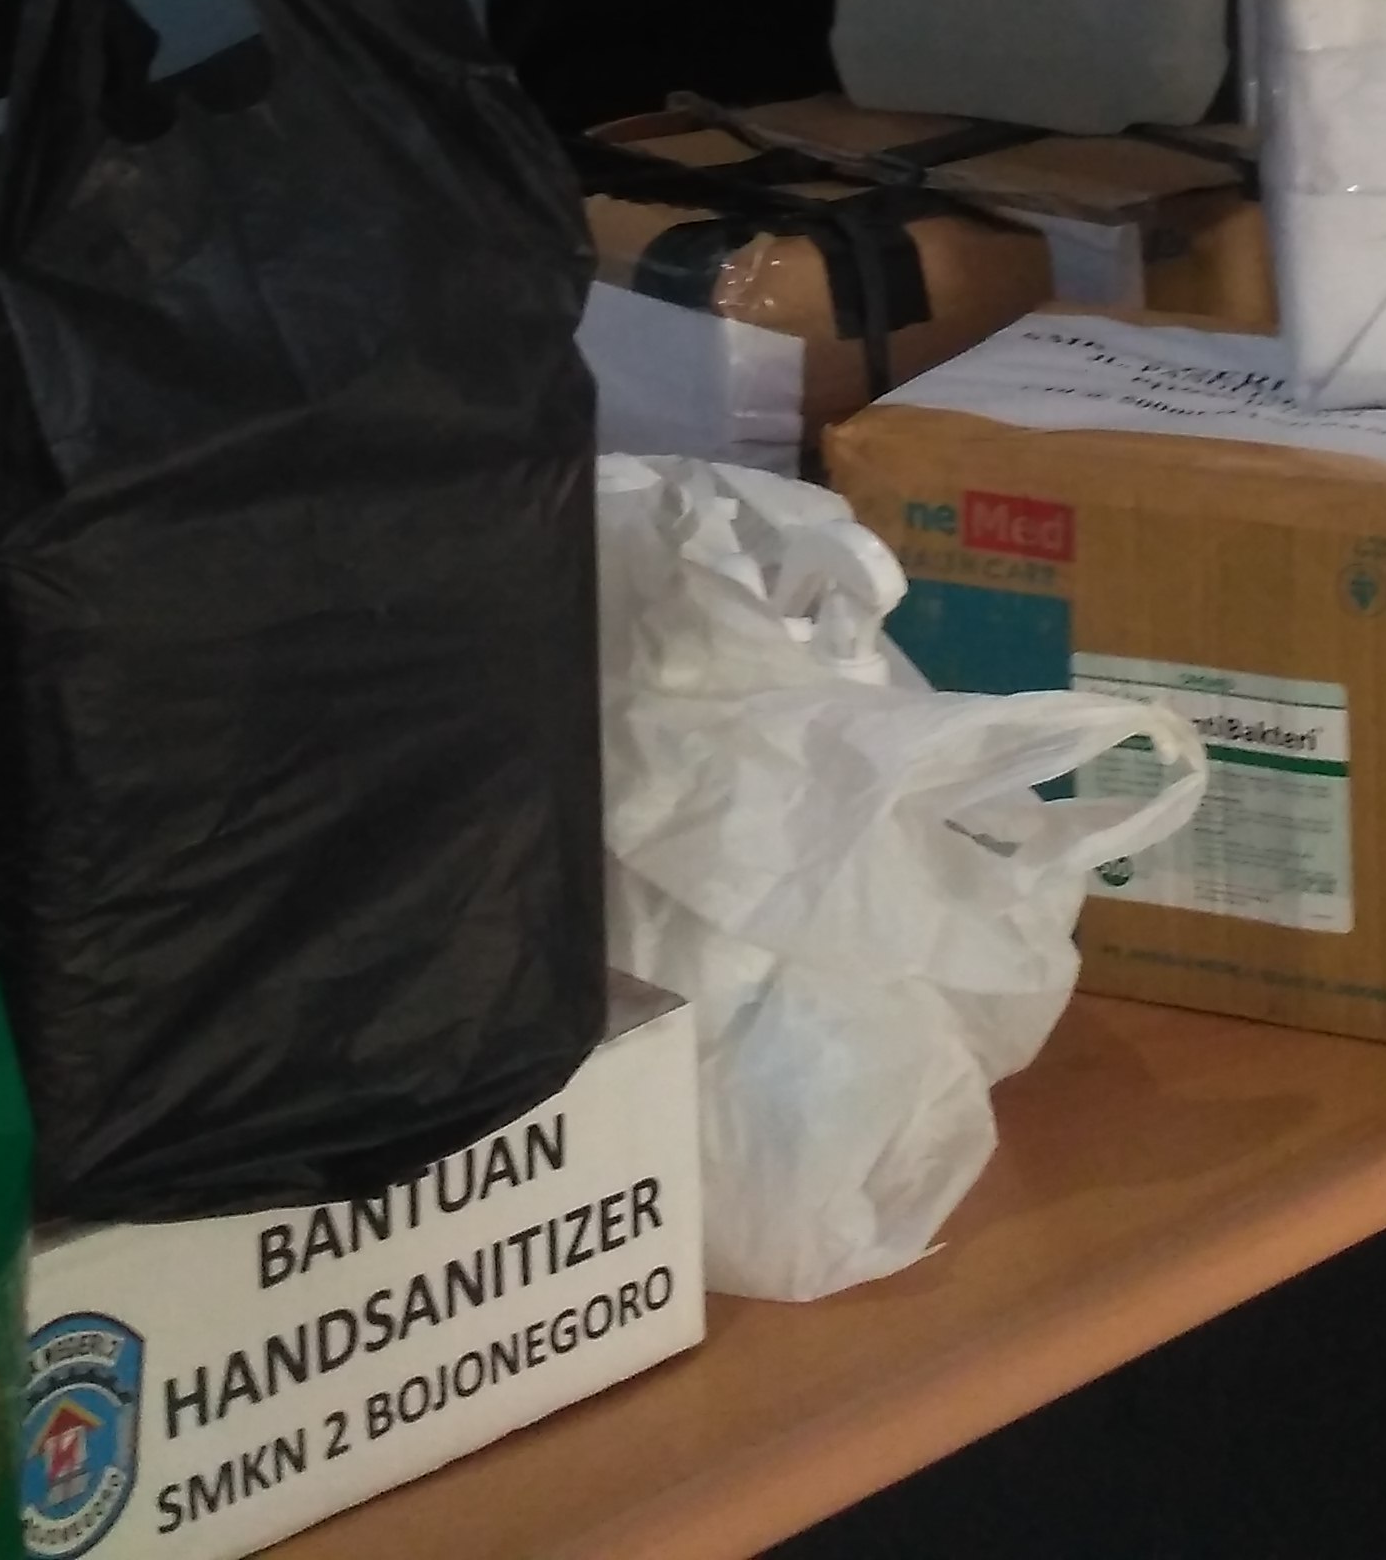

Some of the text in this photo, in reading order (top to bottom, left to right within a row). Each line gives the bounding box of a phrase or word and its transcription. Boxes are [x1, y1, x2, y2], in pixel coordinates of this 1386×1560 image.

[162, 1176, 663, 1439] HANDSANITIZER
[259, 1112, 567, 1290] BANTUAN
[156, 1264, 675, 1535] SMKN 2 BOJONEGORO
